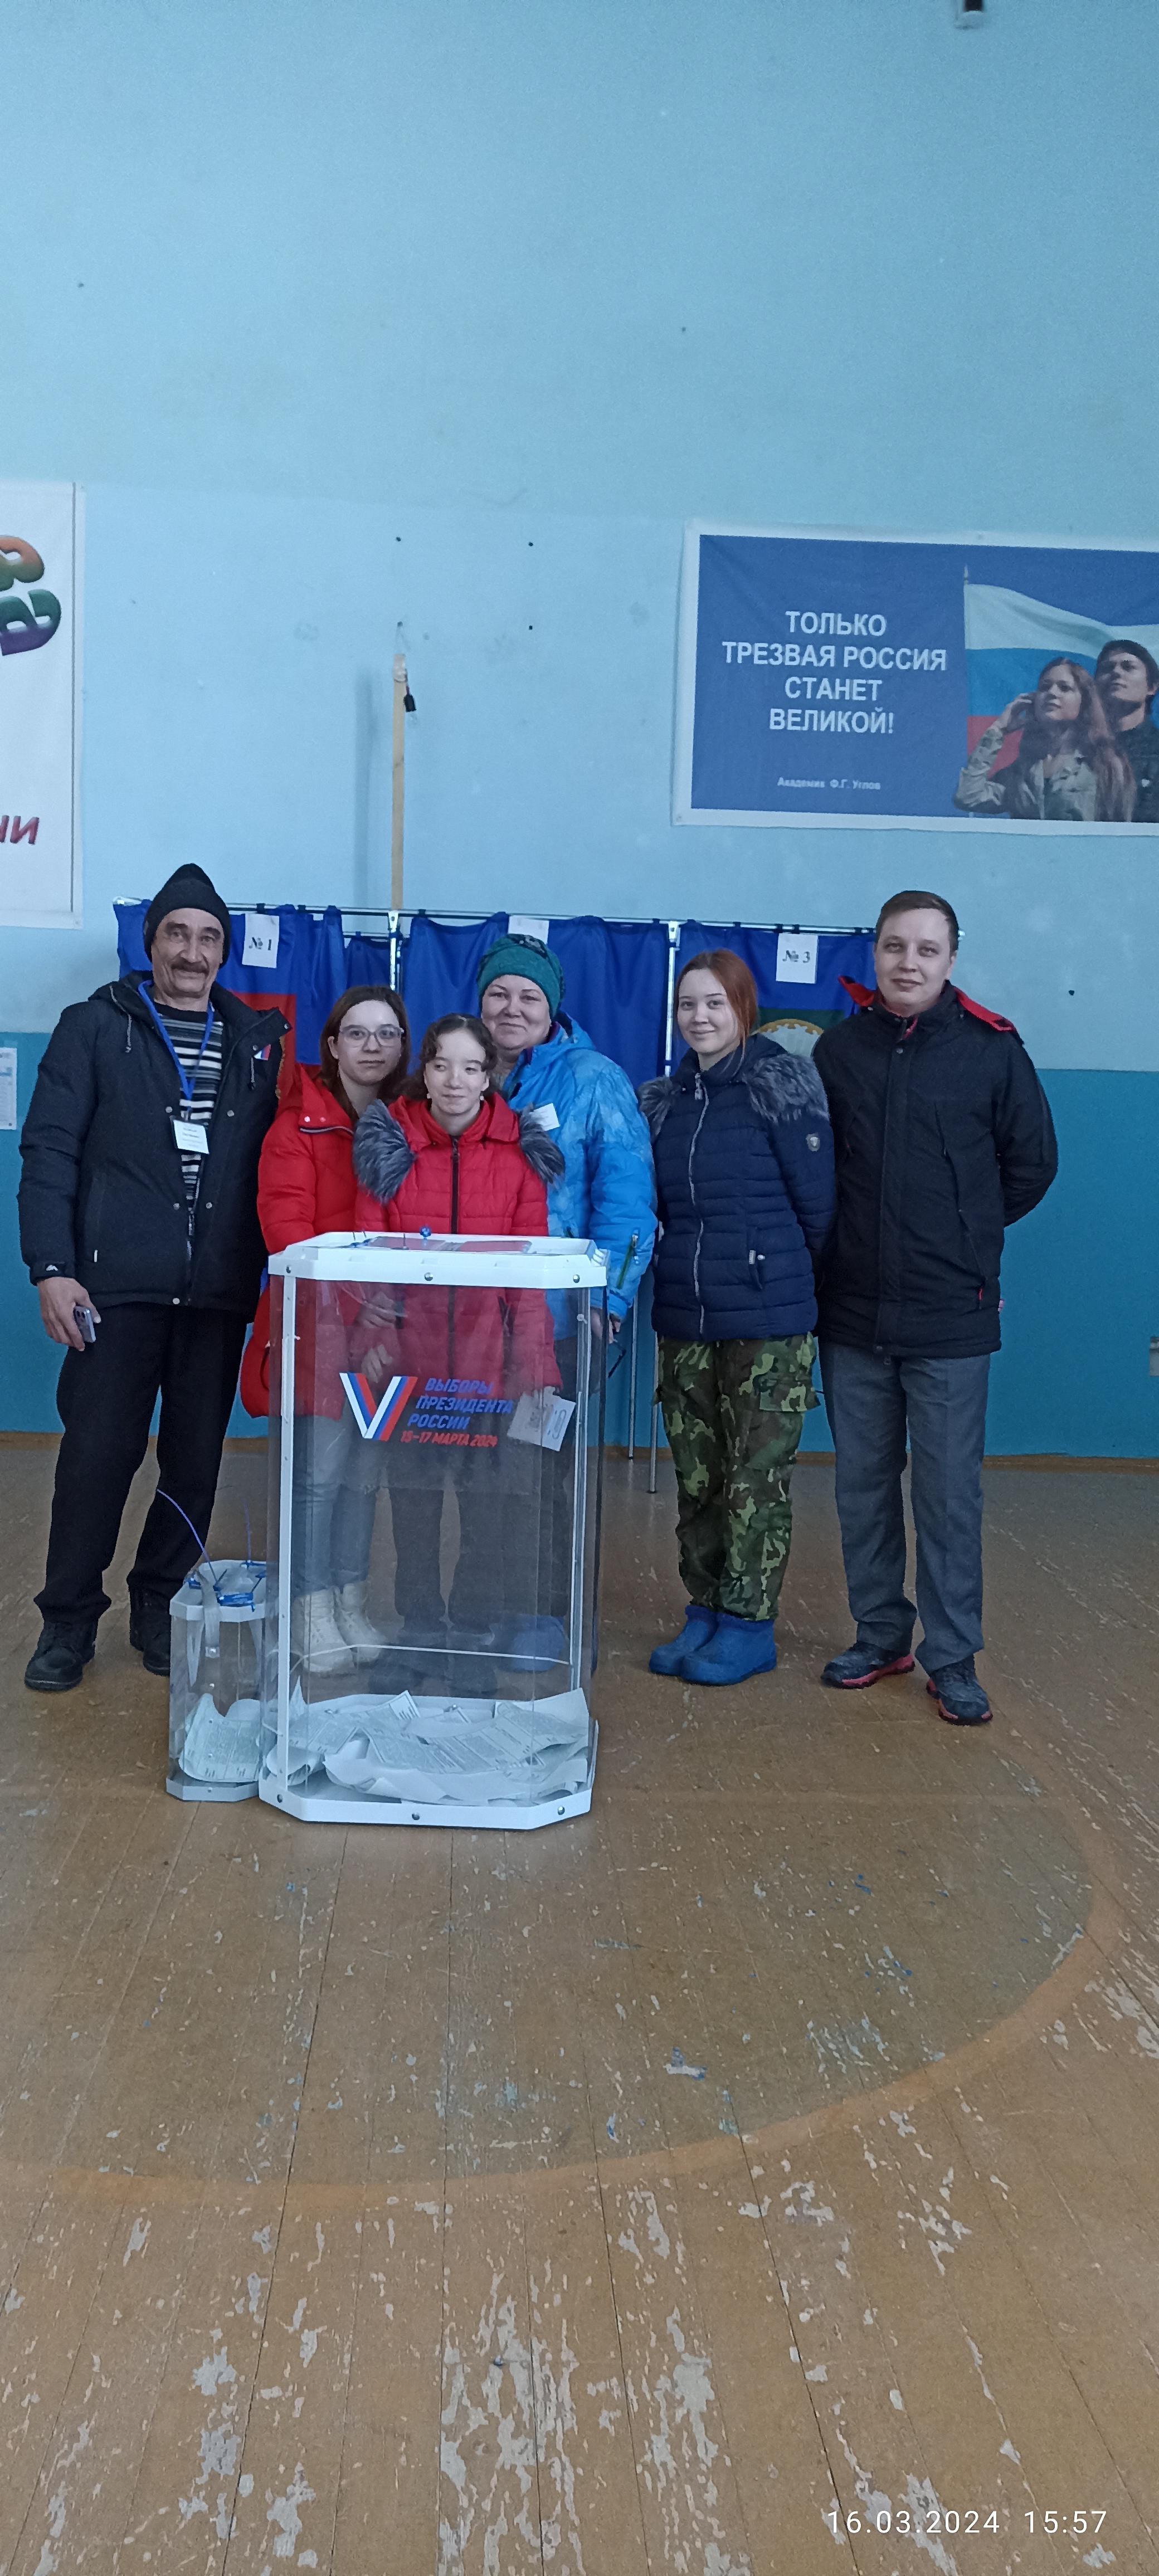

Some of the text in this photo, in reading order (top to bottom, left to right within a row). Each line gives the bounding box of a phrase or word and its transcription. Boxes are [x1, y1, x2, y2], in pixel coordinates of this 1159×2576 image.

[786, 611, 887, 636] ТОЛЬКО
[722, 641, 947, 671] ТРЕЗВАЯ РОССИЯ
[785, 676, 883, 701] СТАНЕТ
[770, 706, 894, 734] ВЕЛИКОЙ!
[249, 936, 264, 950] №
[782, 950, 811, 963] № 3
[425, 1378, 495, 1394] ВЫБОРЫ
[415, 1395, 514, 1414] ПРЕЗИДЕНТА
[407, 1413, 471, 1430] РОССИИ
[431, 1432, 470, 1446] МАРТА
